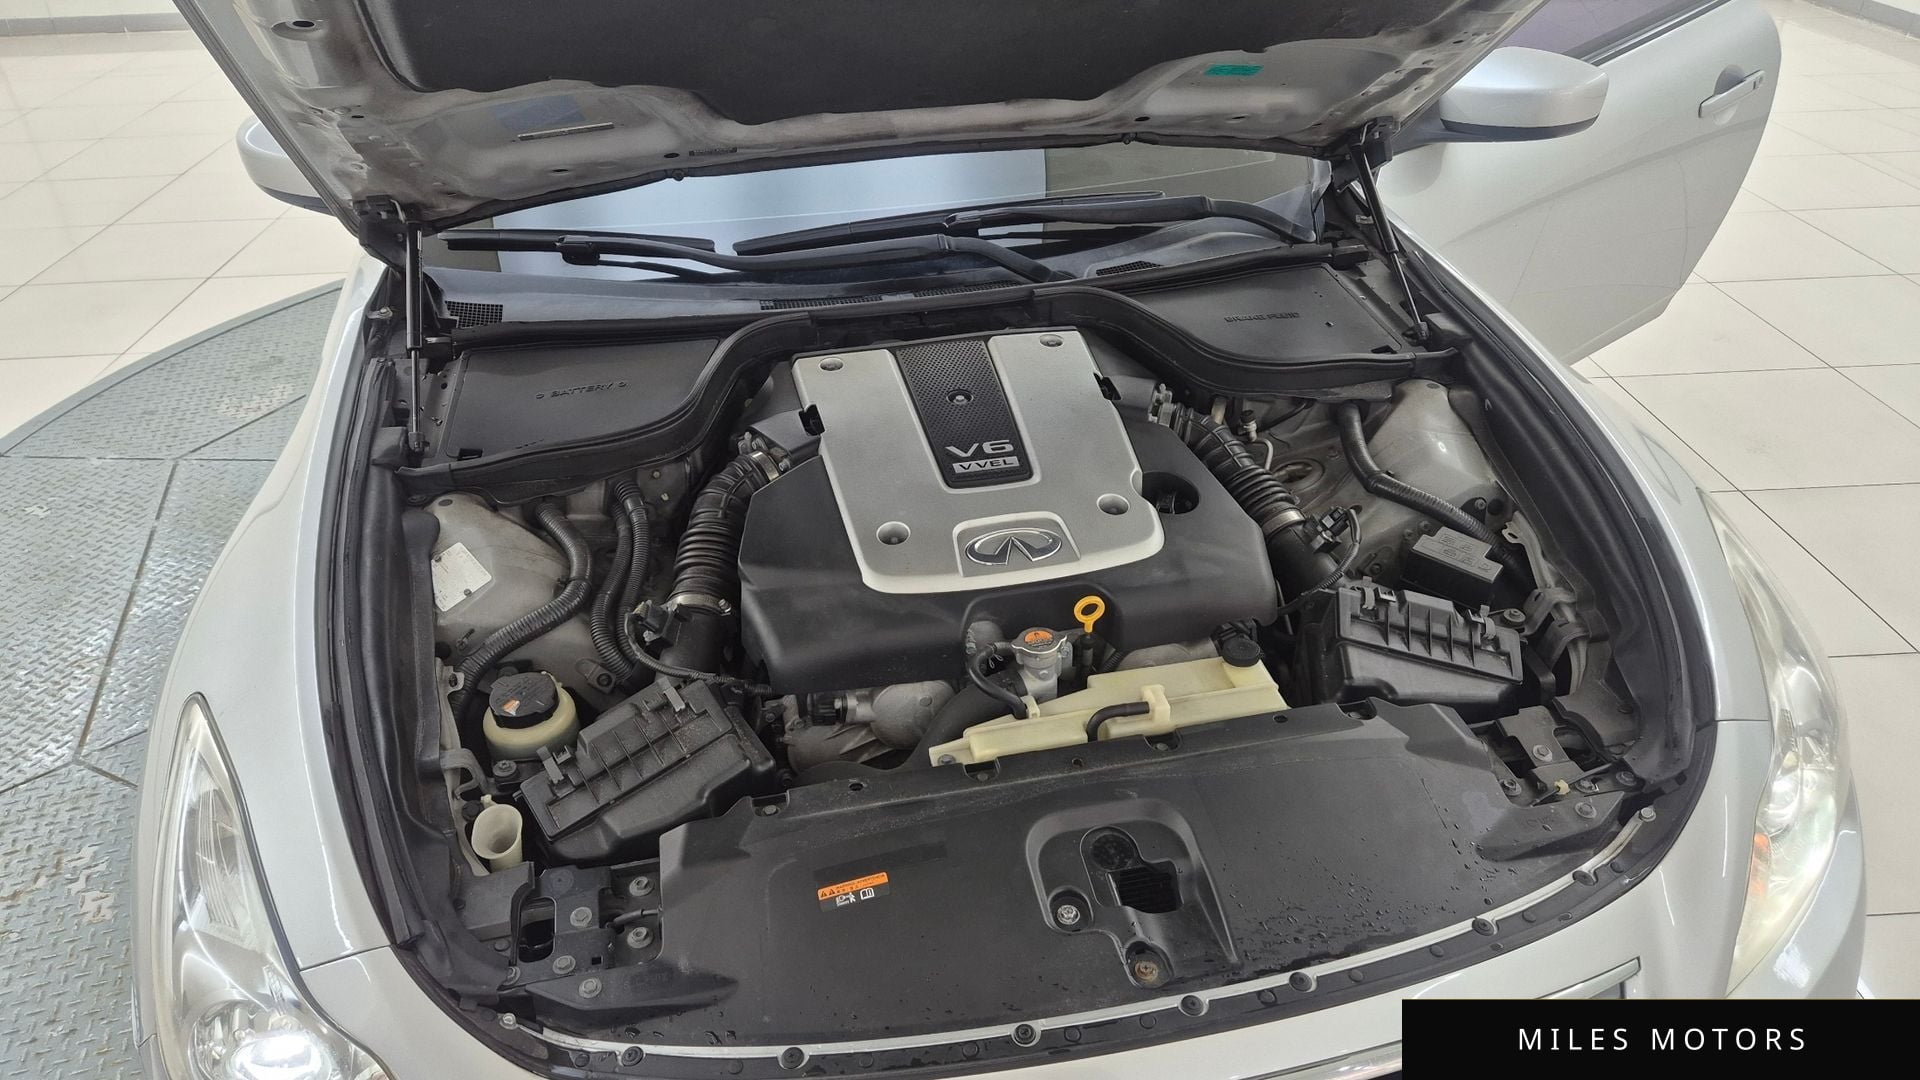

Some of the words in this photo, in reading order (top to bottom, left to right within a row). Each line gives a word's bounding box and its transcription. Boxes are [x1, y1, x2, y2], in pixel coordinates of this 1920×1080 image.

[550, 382, 614, 398] BATTERY
[945, 439, 1014, 458] V6
[959, 458, 1014, 470] VVEL
